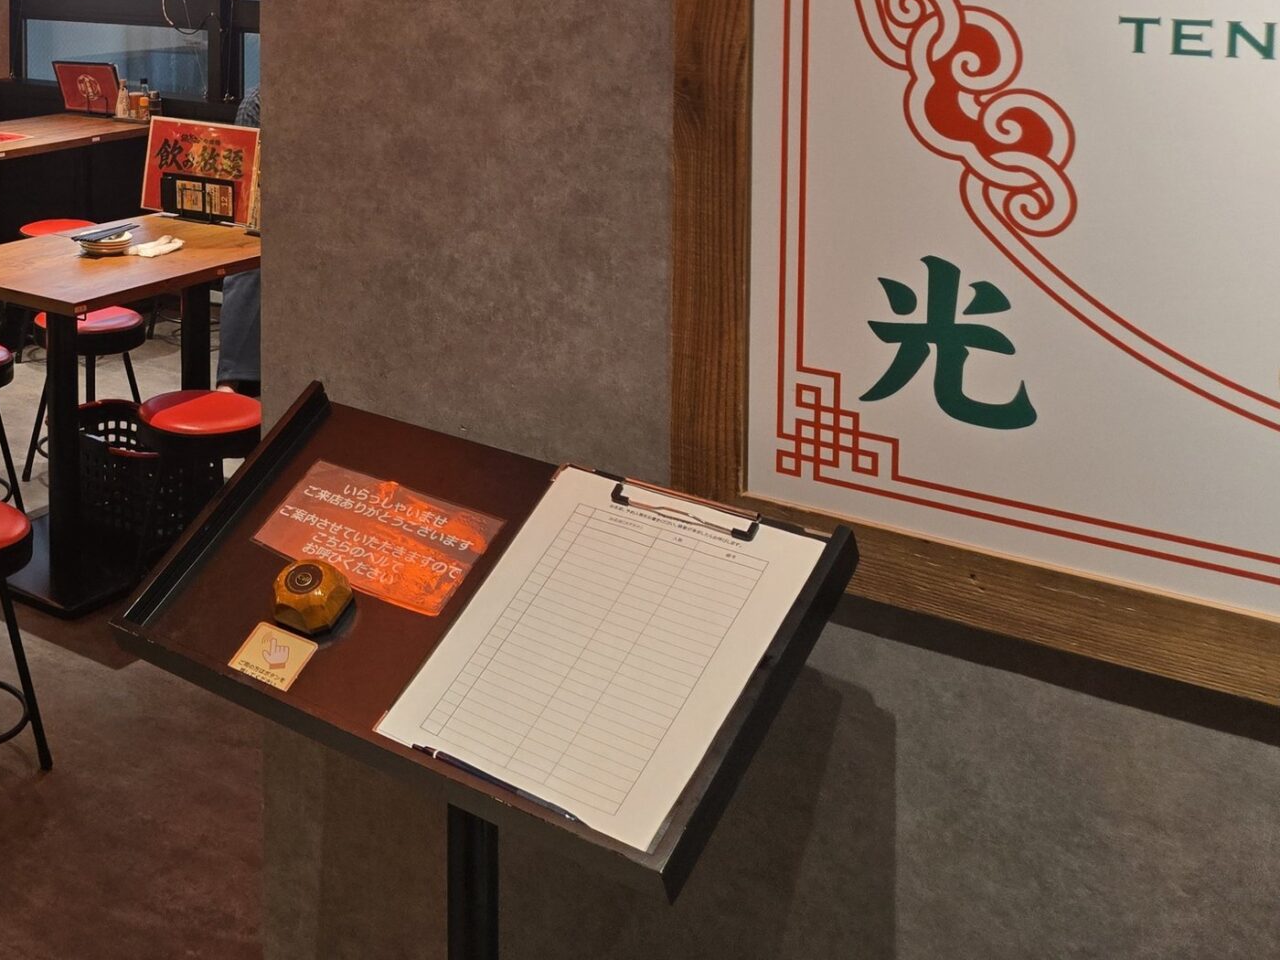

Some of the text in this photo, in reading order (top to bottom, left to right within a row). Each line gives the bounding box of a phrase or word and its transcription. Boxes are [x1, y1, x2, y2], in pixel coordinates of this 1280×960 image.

[1118, 15, 1280, 61] TEN
[156, 137, 243, 179] 飲み放題
[858, 255, 1038, 430] 光
[303, 485, 474, 551] ご来店ありがとうございます
[343, 484, 448, 528] いらっしゃいませ
[279, 504, 463, 579] ご案内させていただきますので
[302, 542, 395, 585] お呼びください
